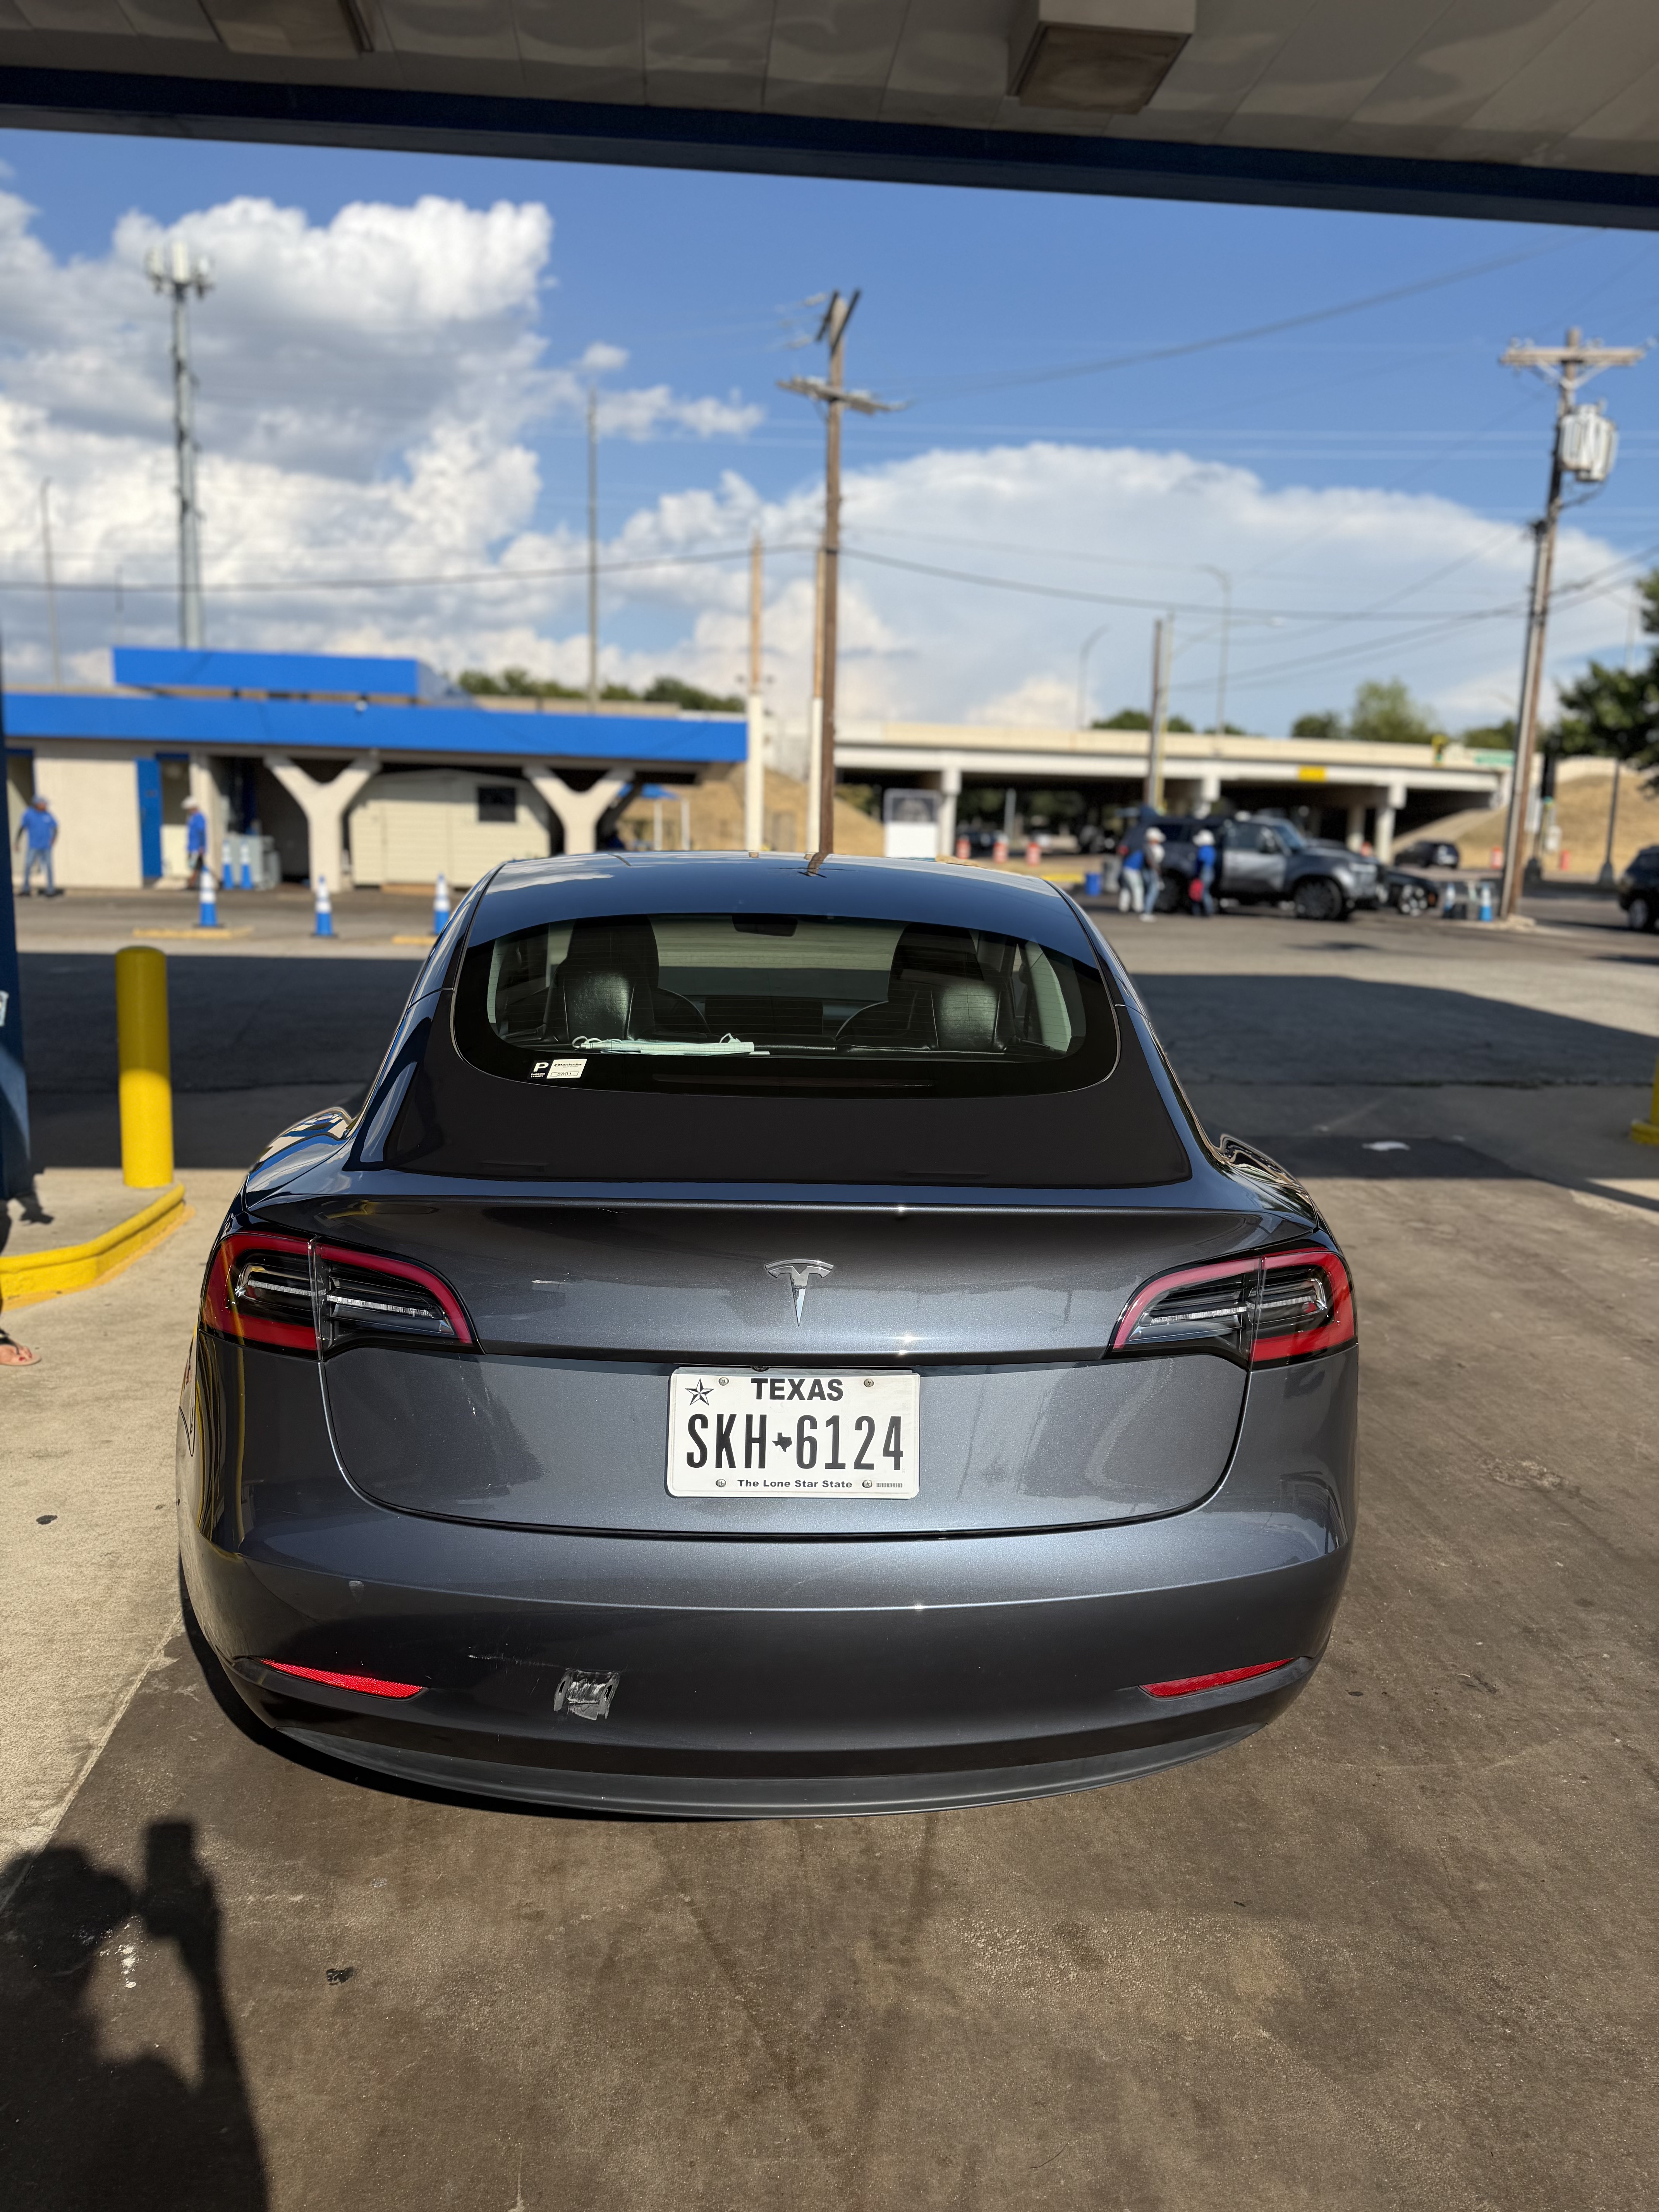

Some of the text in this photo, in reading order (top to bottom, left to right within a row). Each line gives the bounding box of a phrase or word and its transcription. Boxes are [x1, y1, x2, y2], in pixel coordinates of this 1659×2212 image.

[533, 1062, 549, 1072] P
[751, 1378, 843, 1401] TEXAS
[686, 1413, 903, 1470] SKH 6124
